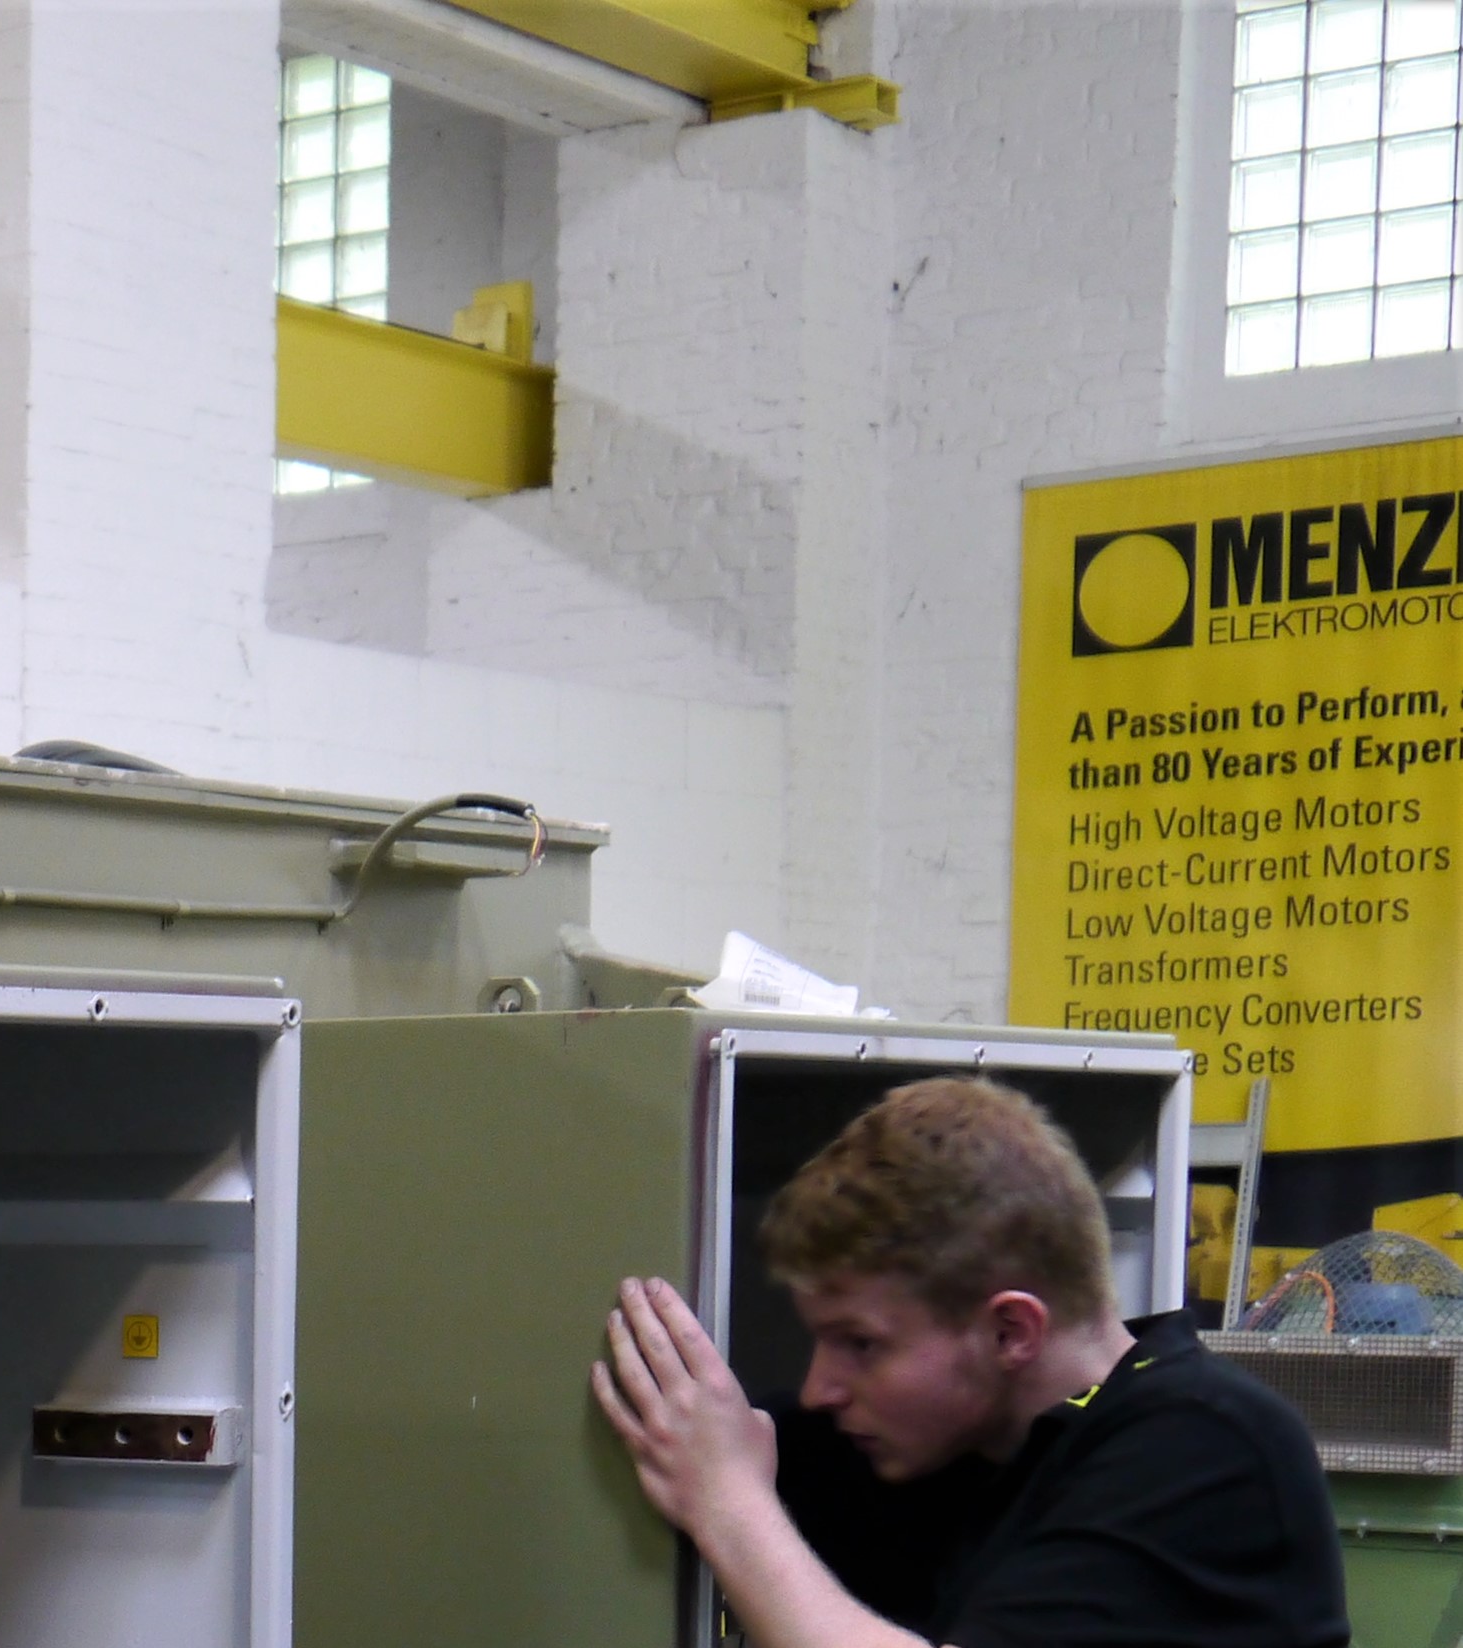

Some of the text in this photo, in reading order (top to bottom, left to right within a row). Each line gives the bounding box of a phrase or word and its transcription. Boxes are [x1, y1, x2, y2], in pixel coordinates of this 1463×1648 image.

[1210, 490, 1463, 609] MENZ
[1071, 711, 1094, 742] A
[1106, 701, 1239, 740] Passion
[1251, 700, 1285, 728] to
[1298, 686, 1448, 724] Perform,
[1069, 758, 1141, 789] than
[1152, 750, 1191, 783] 80
[1202, 747, 1297, 780] Years
[1308, 737, 1342, 772] of
[1070, 796, 1421, 851] High Voltage Motors
[1068, 842, 1451, 893] Direct-Current Motors
[1067, 895, 1410, 940] Low Voltage Motors
[1064, 950, 1289, 986] Transformers
[1064, 993, 1423, 1035] Frequency Converters
[1223, 1042, 1295, 1075] Sets
